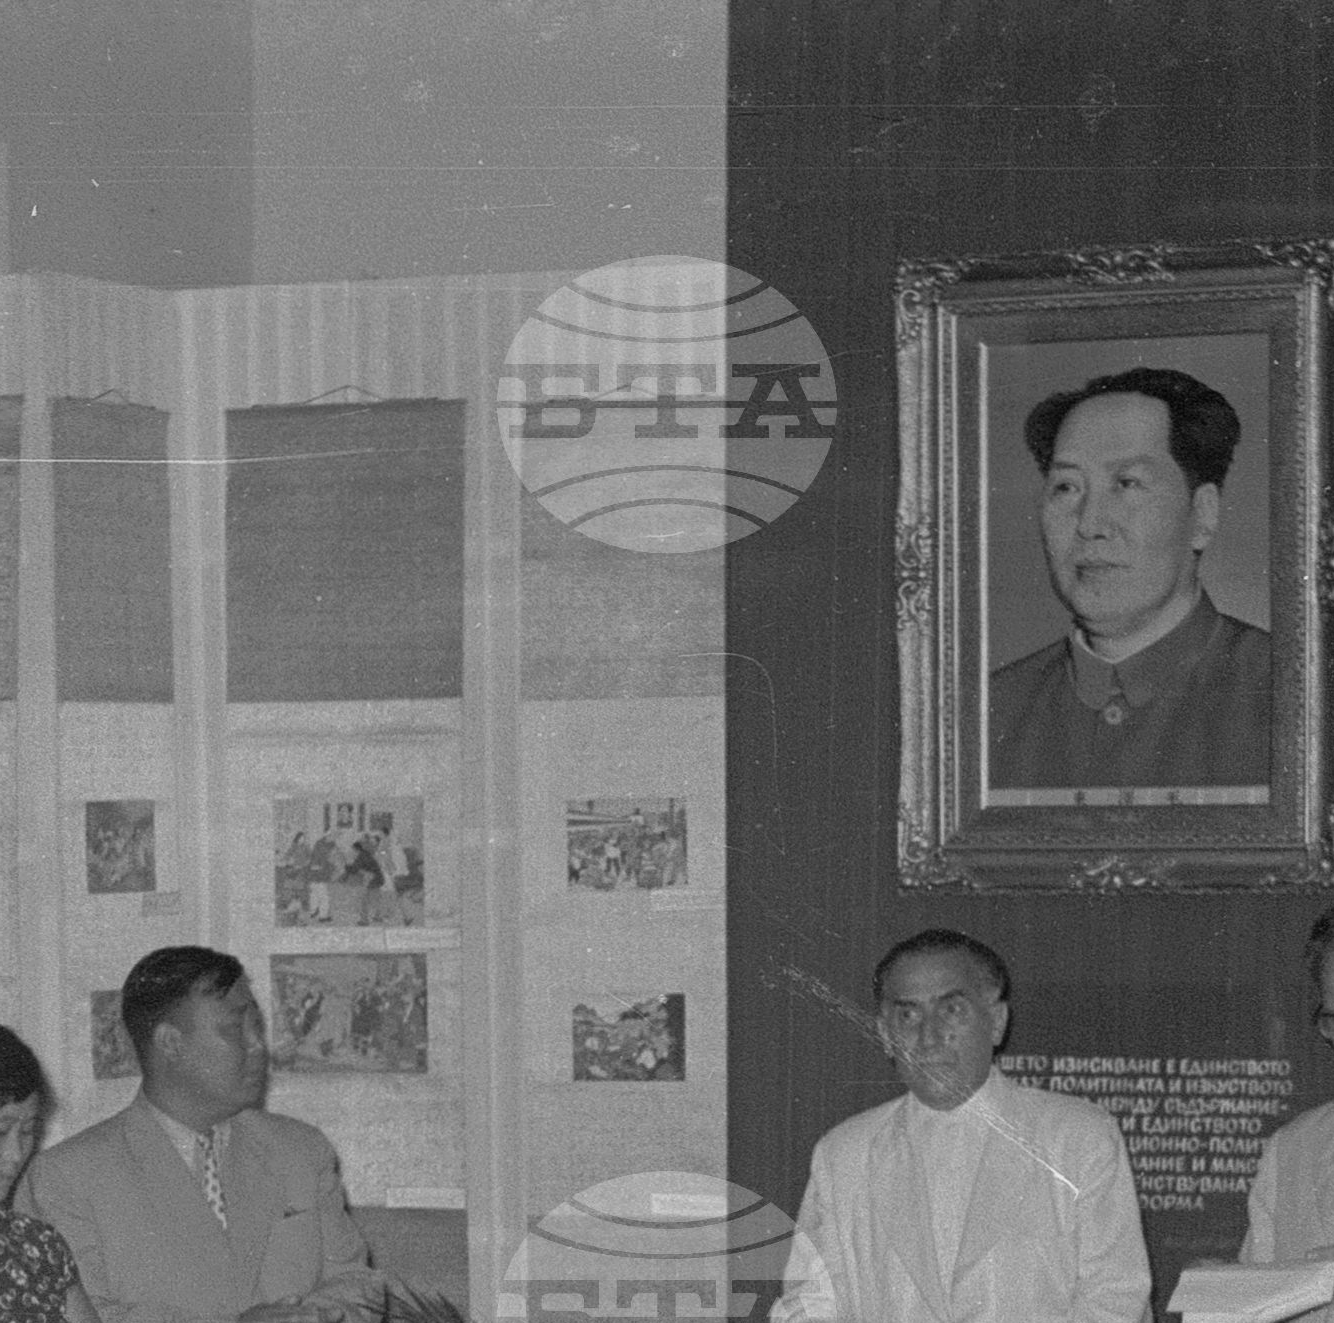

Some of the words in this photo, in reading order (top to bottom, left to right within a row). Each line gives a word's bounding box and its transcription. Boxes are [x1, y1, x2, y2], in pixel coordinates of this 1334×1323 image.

[1053, 1057, 1161, 1074] ИЗИСКВАНЕ
[1166, 1059, 1176, 1074] Е
[1180, 1059, 1292, 1077] ЕДИНСТВОТО
[1049, 1076, 1166, 1093] ПОЛИТИКАТА
[1169, 1078, 1183, 1093] И
[1122, 1116, 1136, 1132] И
[1142, 1116, 1263, 1135] ЕДИНСТВОТО
[1192, 1157, 1206, 1172] И
[1136, 1174, 1256, 1194] НСТВУВАНА
